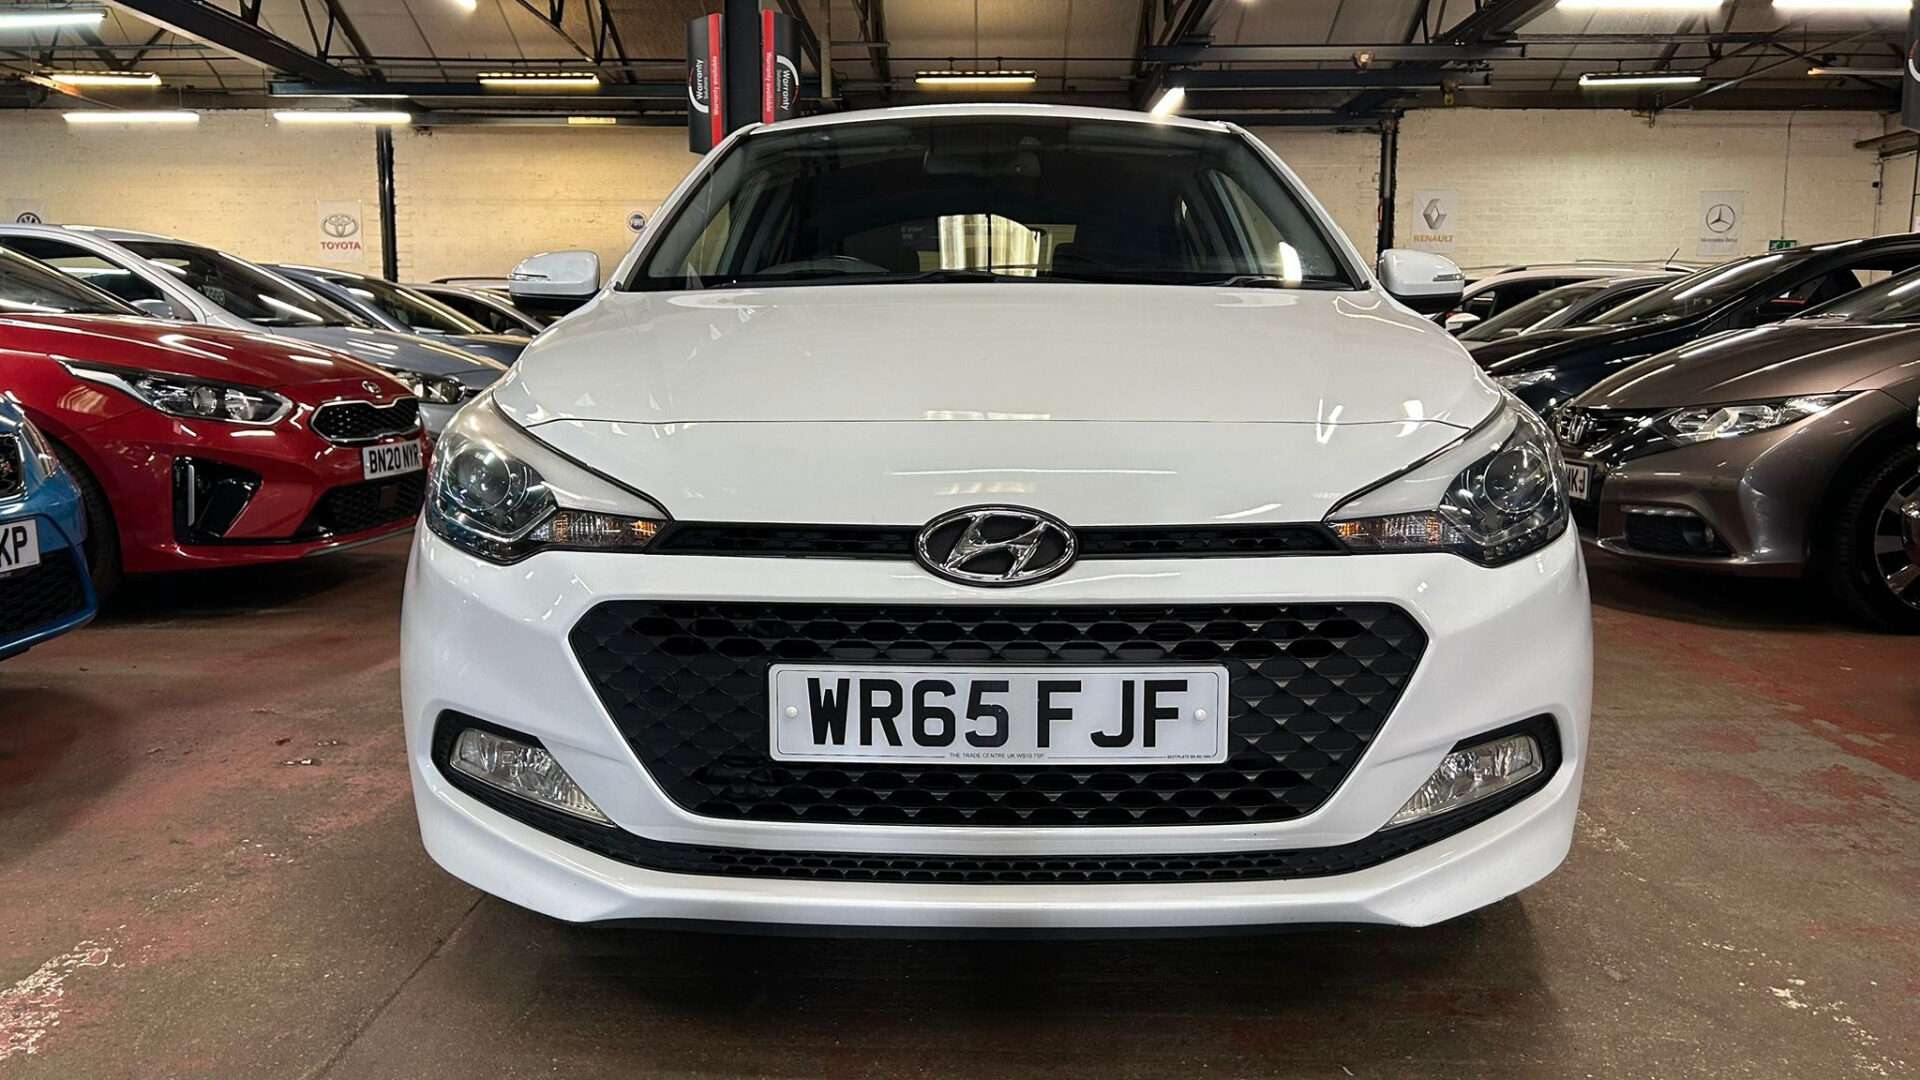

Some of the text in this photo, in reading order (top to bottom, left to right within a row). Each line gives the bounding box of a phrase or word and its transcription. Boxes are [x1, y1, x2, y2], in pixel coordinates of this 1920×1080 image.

[695, 59, 704, 100] Warranty
[781, 69, 790, 110] Warranty
[320, 241, 361, 250] TOYOTA
[368, 446, 401, 474] BN20
[807, 677, 1188, 749] WR65 FJF
